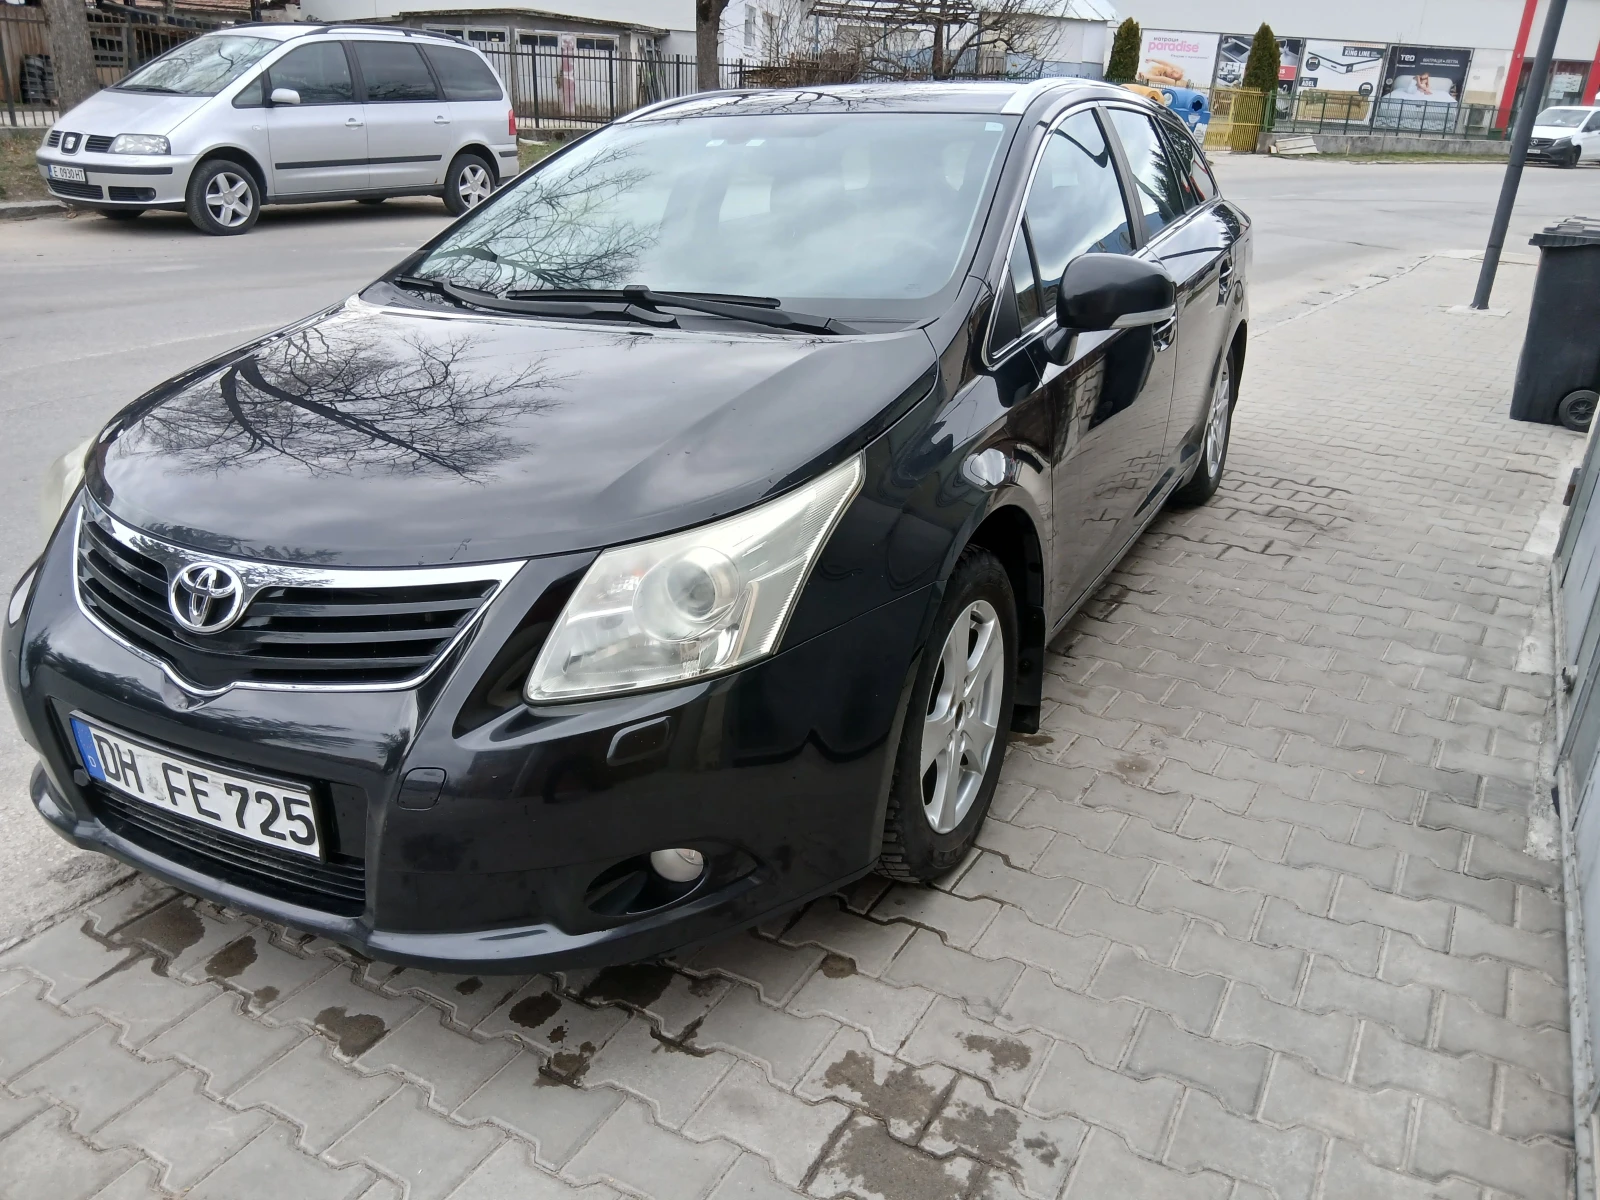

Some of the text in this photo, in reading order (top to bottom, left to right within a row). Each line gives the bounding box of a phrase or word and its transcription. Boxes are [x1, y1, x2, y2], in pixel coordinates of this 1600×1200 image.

[1148, 40, 1199, 53] paradise
[1344, 49, 1358, 57] KING
[1358, 50, 1371, 58] LINE
[93, 733, 316, 846] DH FE 725
